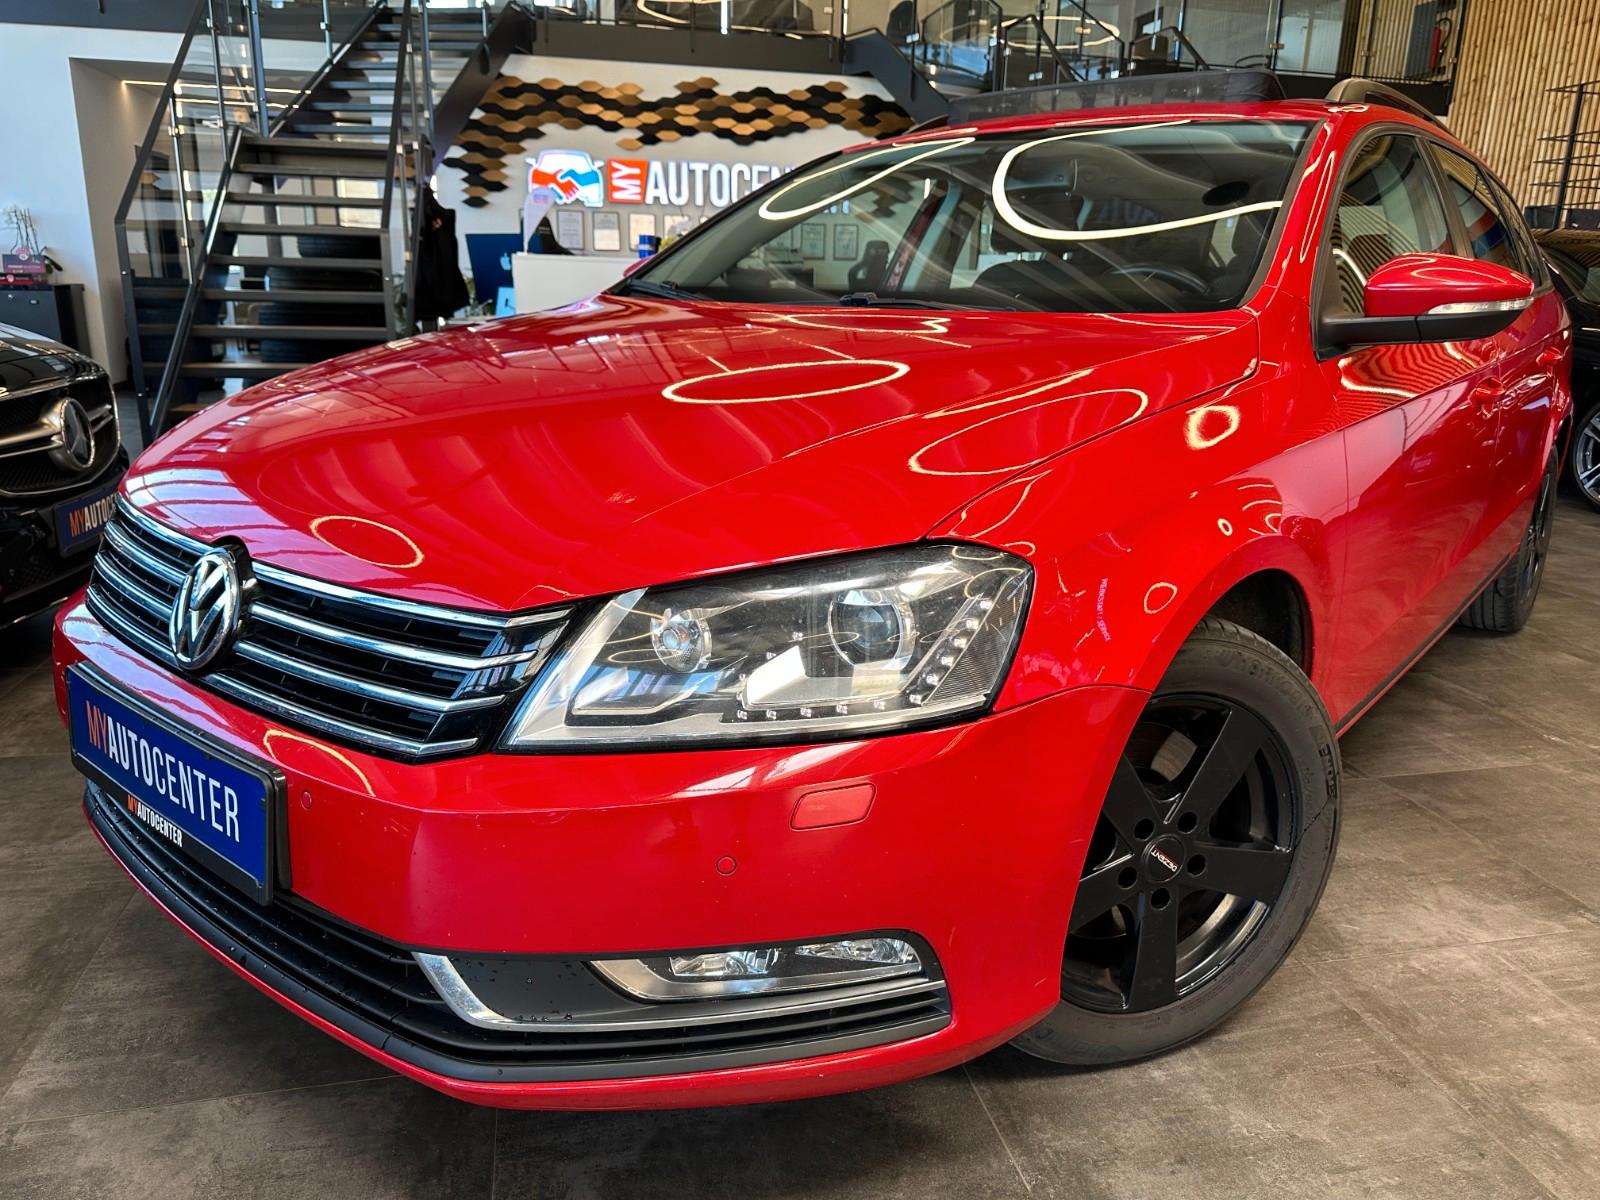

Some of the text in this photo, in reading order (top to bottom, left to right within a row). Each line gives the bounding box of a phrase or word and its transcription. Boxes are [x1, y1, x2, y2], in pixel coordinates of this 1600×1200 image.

[611, 161, 642, 200] MY
[86, 701, 240, 843] MYAUTOCENTER
[127, 794, 183, 848] MYAUTOCENTER
